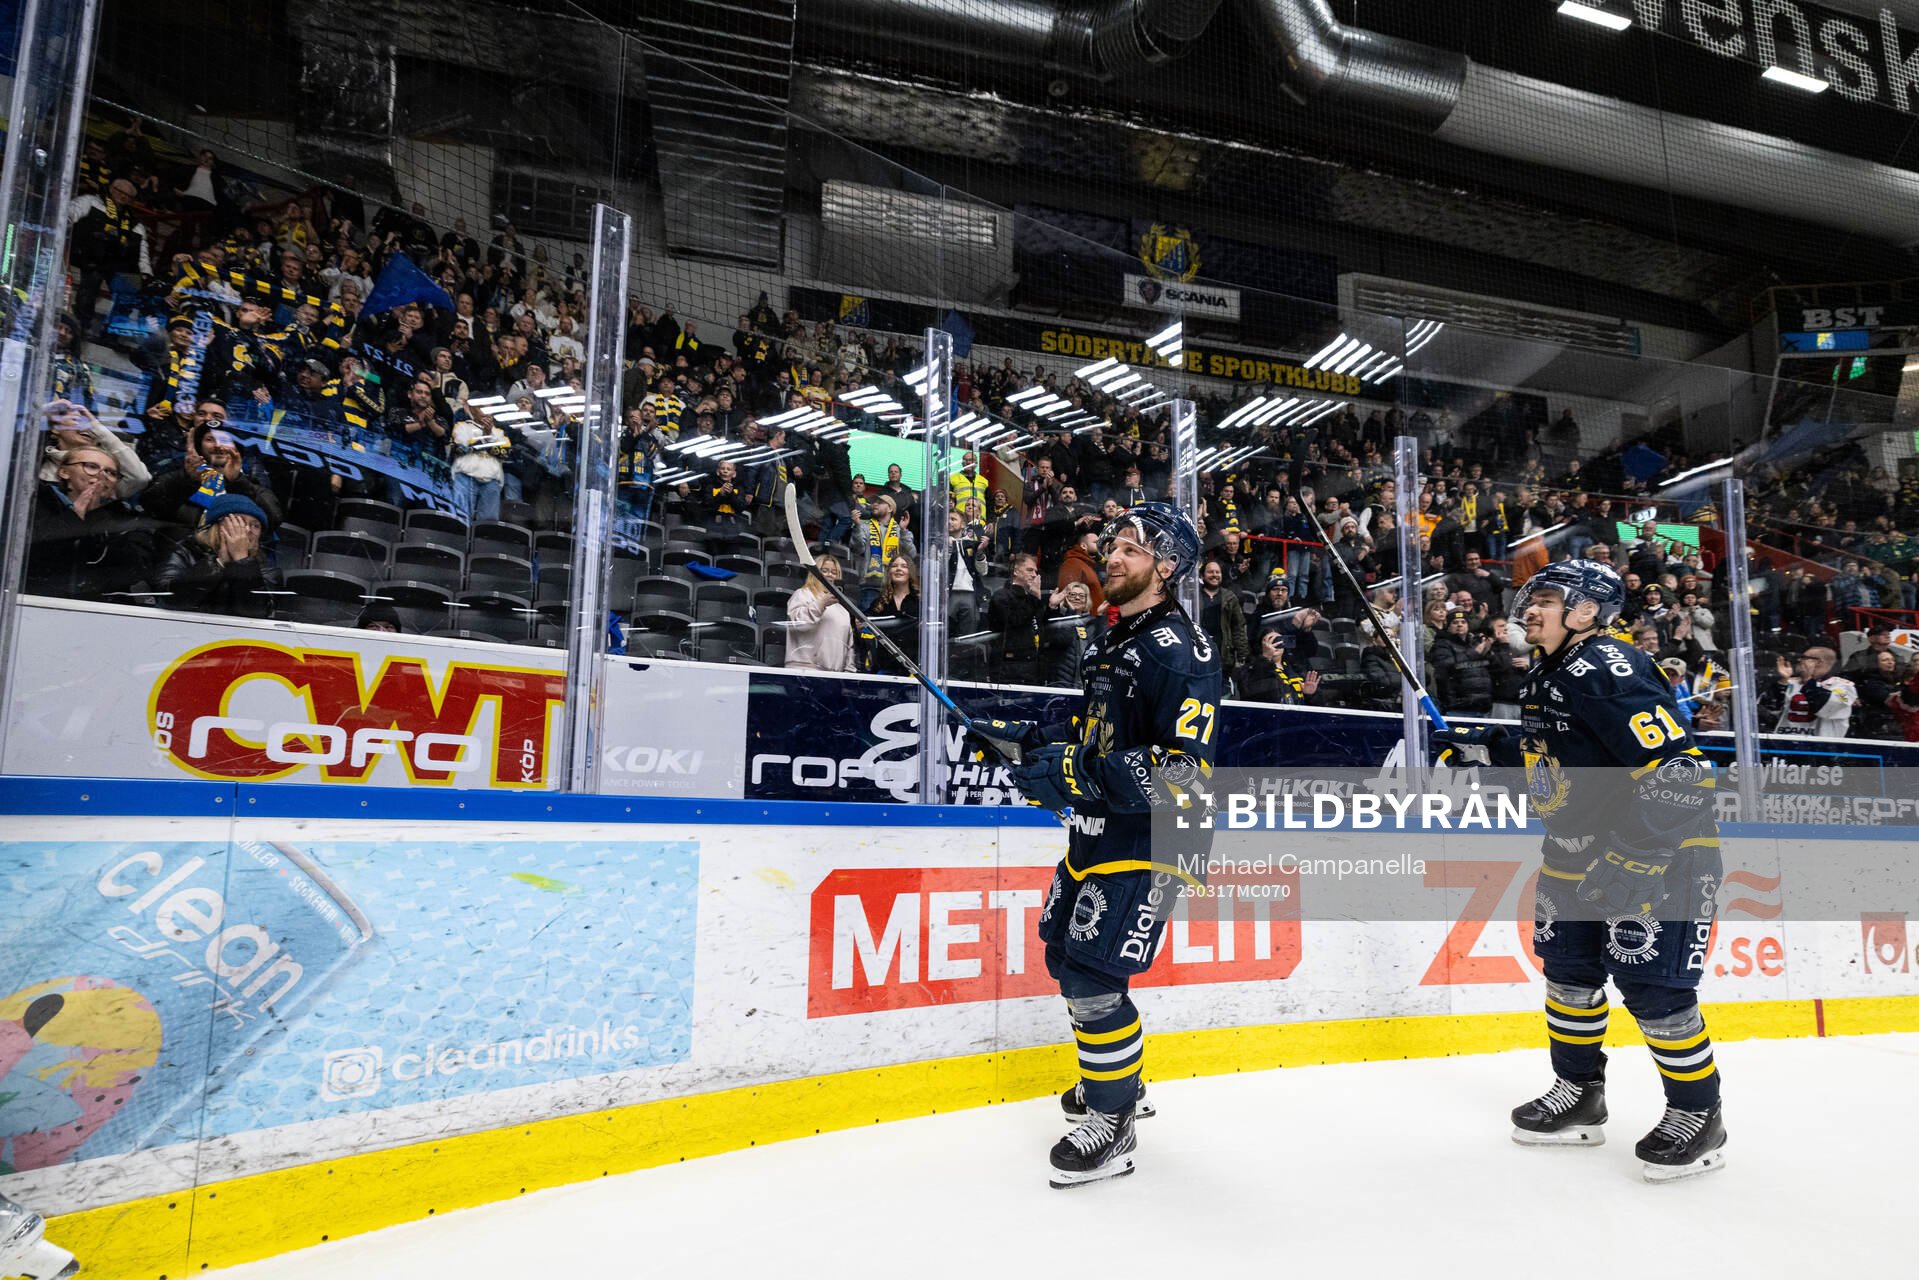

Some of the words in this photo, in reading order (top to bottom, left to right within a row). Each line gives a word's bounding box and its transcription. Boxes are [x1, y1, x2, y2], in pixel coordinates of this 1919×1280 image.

[1165, 288, 1229, 308] SCANIA
[1802, 306, 1884, 332] BST
[1210, 354, 1361, 396] SPORTKLUBB
[1129, 608, 1153, 631] CCM
[147, 638, 568, 788] CWT
[1175, 697, 1215, 745] 27
[1628, 704, 1686, 750] 61
[188, 715, 482, 773] rofo
[1062, 745, 1084, 796] CCM
[1728, 756, 1844, 791] syltar.se
[1604, 851, 1669, 876] CCM
[97, 851, 304, 1013] clean
[831, 886, 1287, 990] METLIT
[1120, 872, 1171, 963] Dialec
[1686, 873, 1717, 971] Dialect
[1605, 942, 1660, 965] SUGBIL.NU
[391, 1020, 641, 1082] cleandrinks
